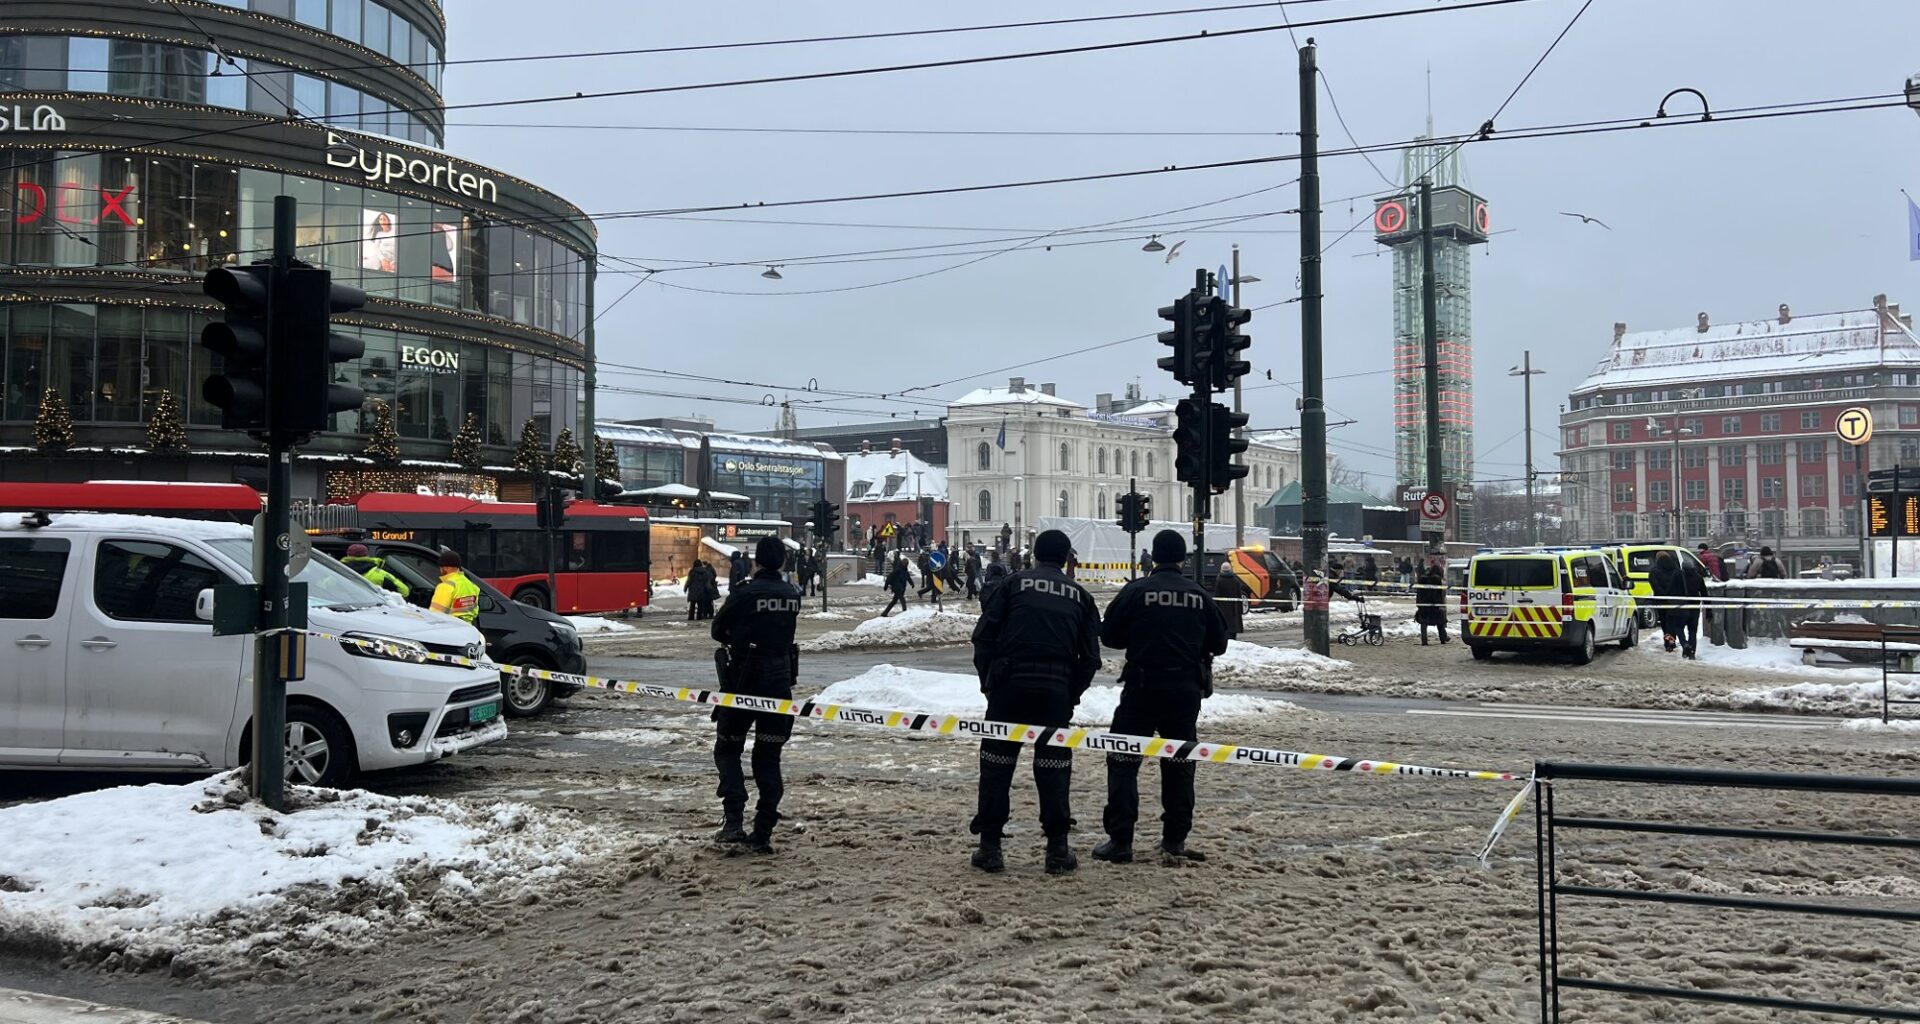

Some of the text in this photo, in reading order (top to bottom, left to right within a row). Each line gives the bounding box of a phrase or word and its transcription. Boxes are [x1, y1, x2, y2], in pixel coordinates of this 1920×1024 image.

[327, 131, 497, 203] Byporten
[401, 345, 459, 369] EGON
[1844, 417, 1860, 436] T
[738, 462, 803, 475] Oslo Sentralstasjon
[372, 531, 415, 541] 31 Grorud T
[1020, 578, 1081, 603] POLITI
[1469, 592, 1505, 601] POLITI
[757, 599, 799, 612] POLITI
[1144, 591, 1204, 610] POLITI
[551, 673, 585, 684] POLITI
[735, 696, 776, 710] POLITI
[839, 711, 884, 725] POLITI
[959, 720, 1008, 736] POLITI
[1086, 737, 1141, 753] POLITI
[1236, 748, 1298, 765] POLITI
